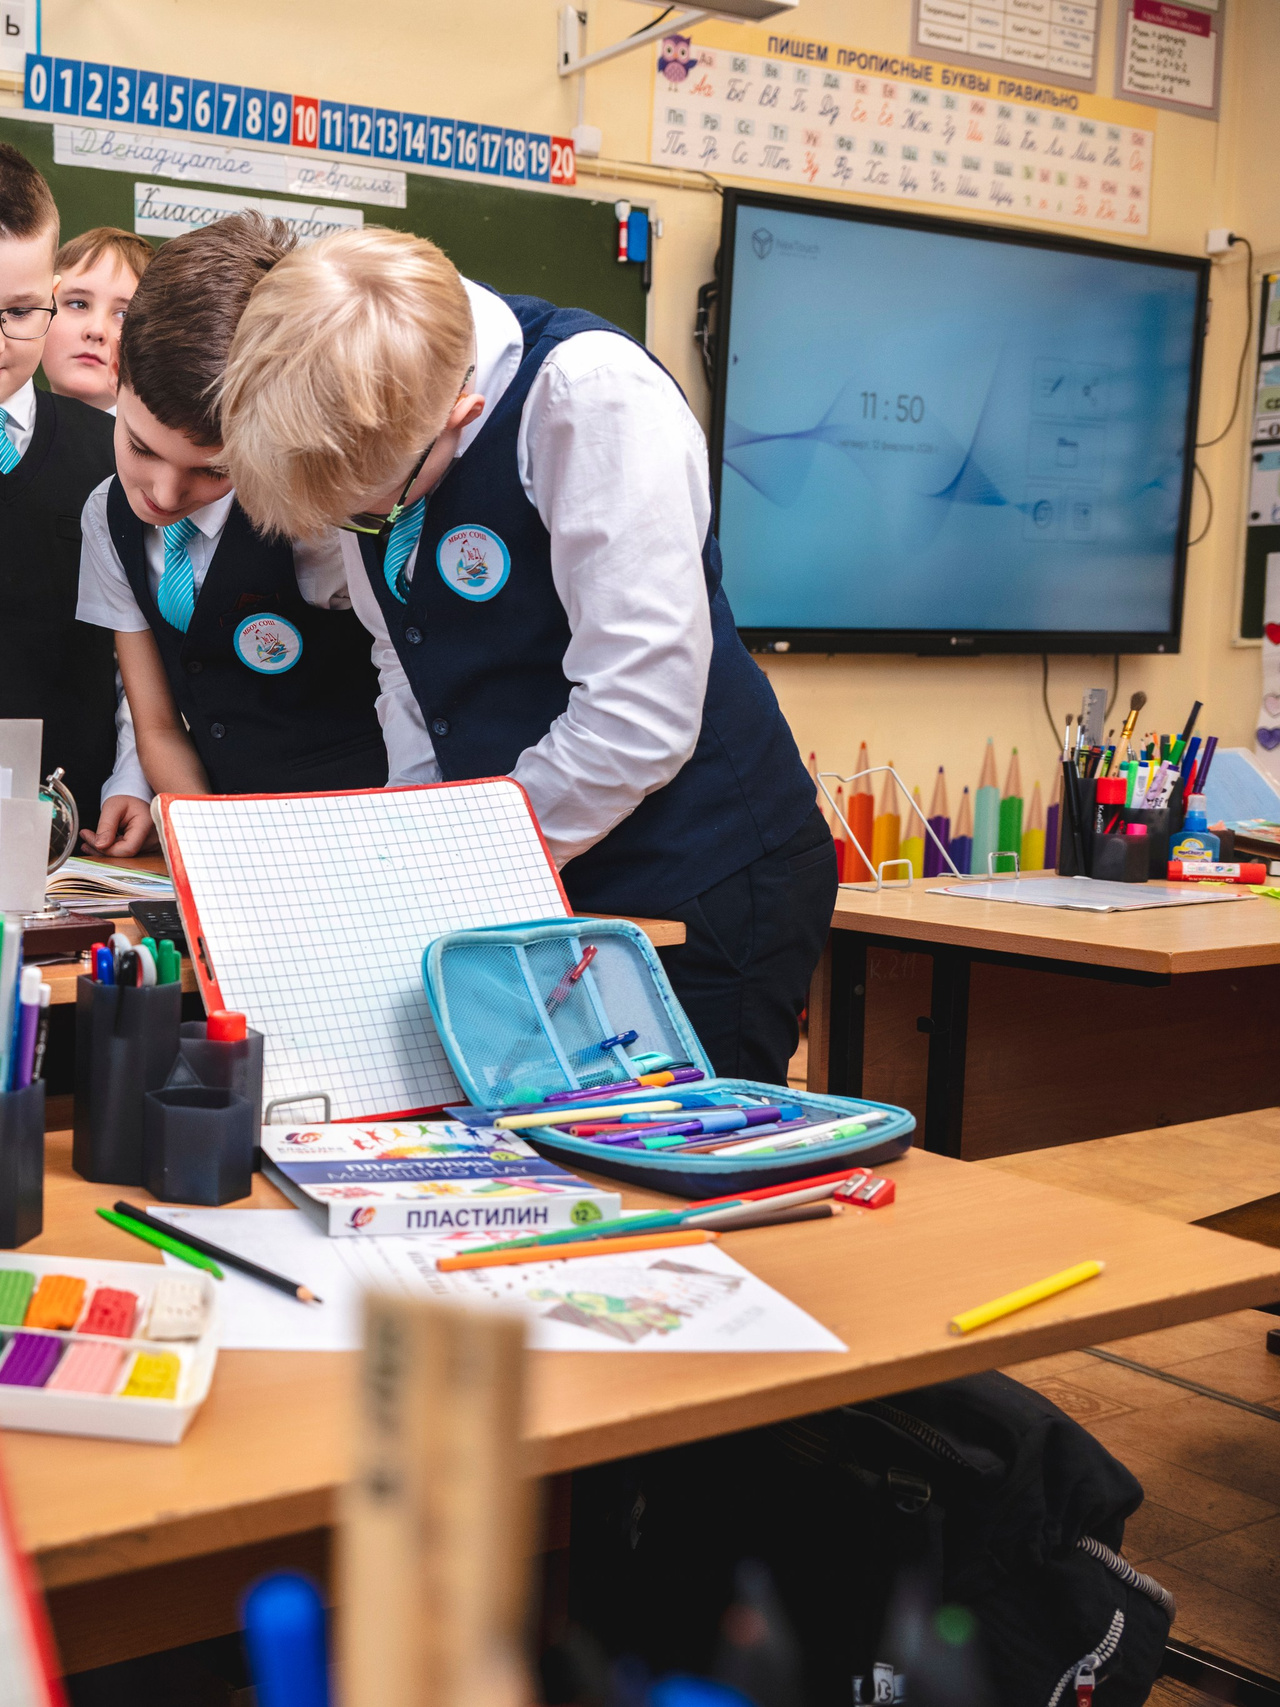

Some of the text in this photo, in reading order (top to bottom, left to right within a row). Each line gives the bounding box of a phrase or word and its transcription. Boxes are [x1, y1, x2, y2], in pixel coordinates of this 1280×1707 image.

[768, 36, 1079, 111] ПИШЕМ ПРОПИСНЫЕ БУКВЫ ПРАВИЛЬНО
[30, 64, 573, 178] 0 1 2 3 4 5 6 7 8 9 10 11 12 13 14 15 16 17 18 19 20
[75, 127, 253, 174] Двенадцатое
[138, 187, 239, 225] Классн
[448, 531, 487, 545] МБОУ СОШ
[327, 1165, 528, 1181] MODELLING CLAY
[345, 1159, 494, 1172] ПЛАСТИЛИН
[407, 1206, 549, 1229] ПЛАСТИЛИН
[575, 1209, 589, 1221] 12
